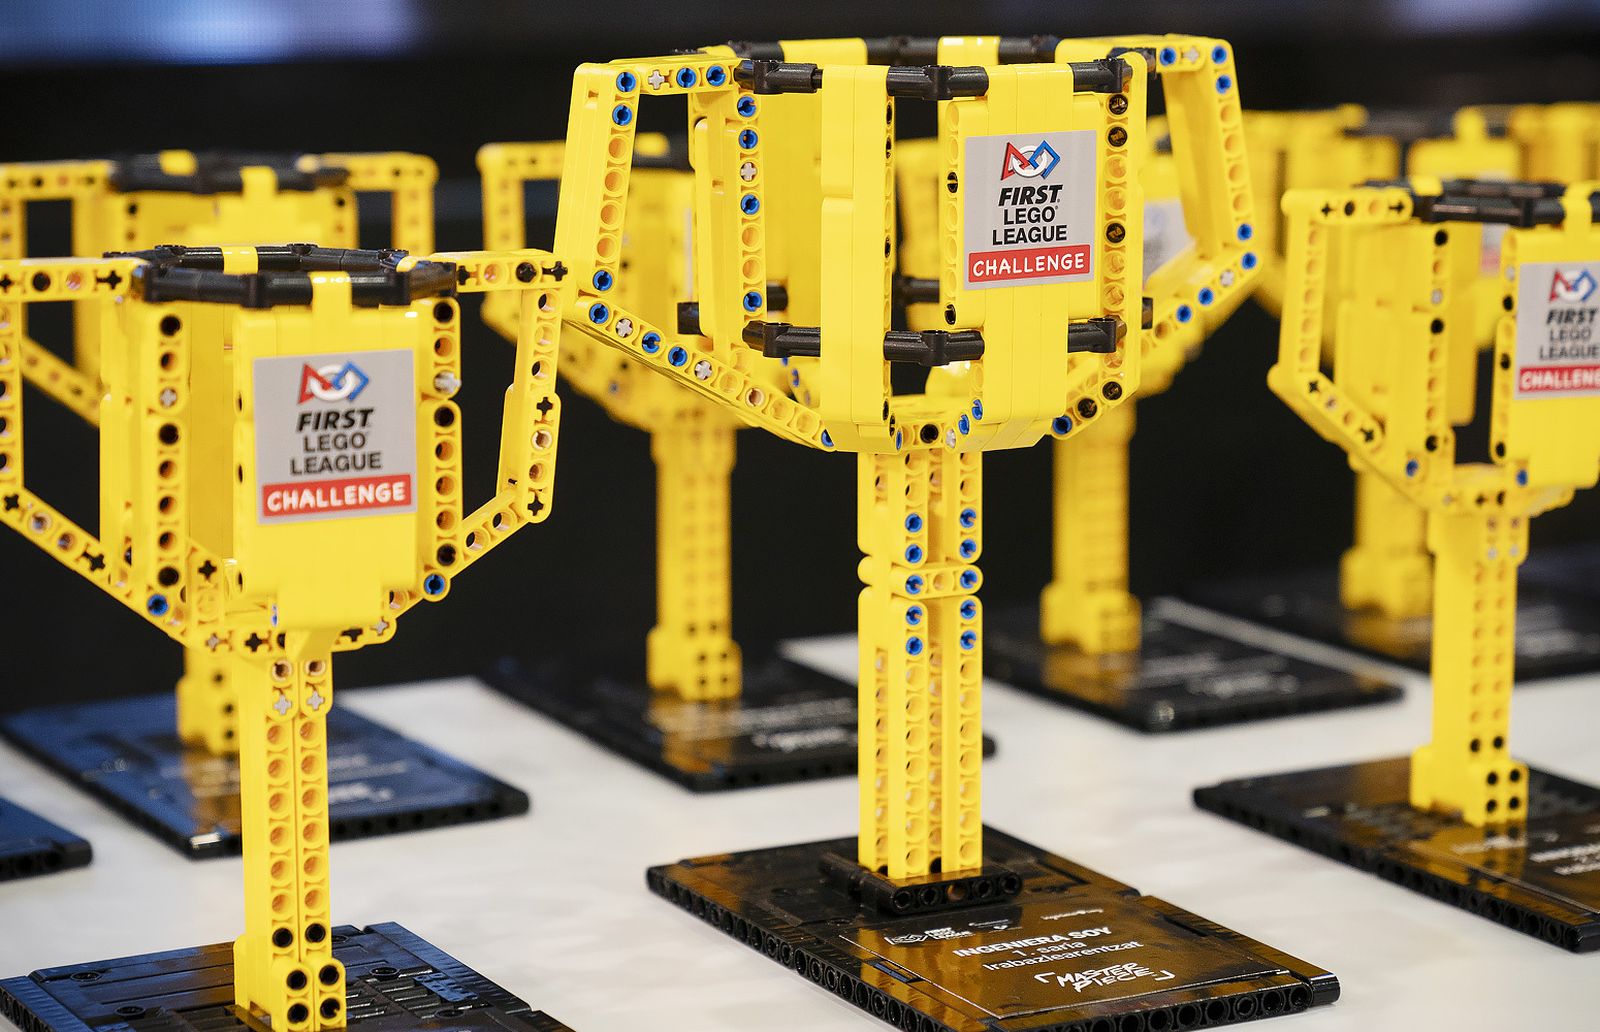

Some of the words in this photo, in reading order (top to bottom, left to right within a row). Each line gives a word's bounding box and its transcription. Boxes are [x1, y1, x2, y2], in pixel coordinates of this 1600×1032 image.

[998, 184, 1063, 206] FIRST
[992, 225, 1067, 245] LEAGUE
[973, 252, 1085, 277] CHALLENGE
[1547, 308, 1599, 324] FIRST
[1550, 328, 1591, 342] LEGO
[1540, 345, 1600, 360] LEAGUE
[297, 408, 374, 432] FIRST
[303, 432, 367, 452] LEGO
[290, 452, 382, 476] LEAGUE
[267, 481, 406, 513] CHALLENGE
[953, 934, 1070, 957] INGENIERA
[1067, 926, 1112, 939] SOY
[1036, 941, 1087, 954] saria
[982, 940, 1144, 971] Irabazlearentzat
[1056, 962, 1144, 988] MASTER
[1072, 967, 1155, 992] PIECE
